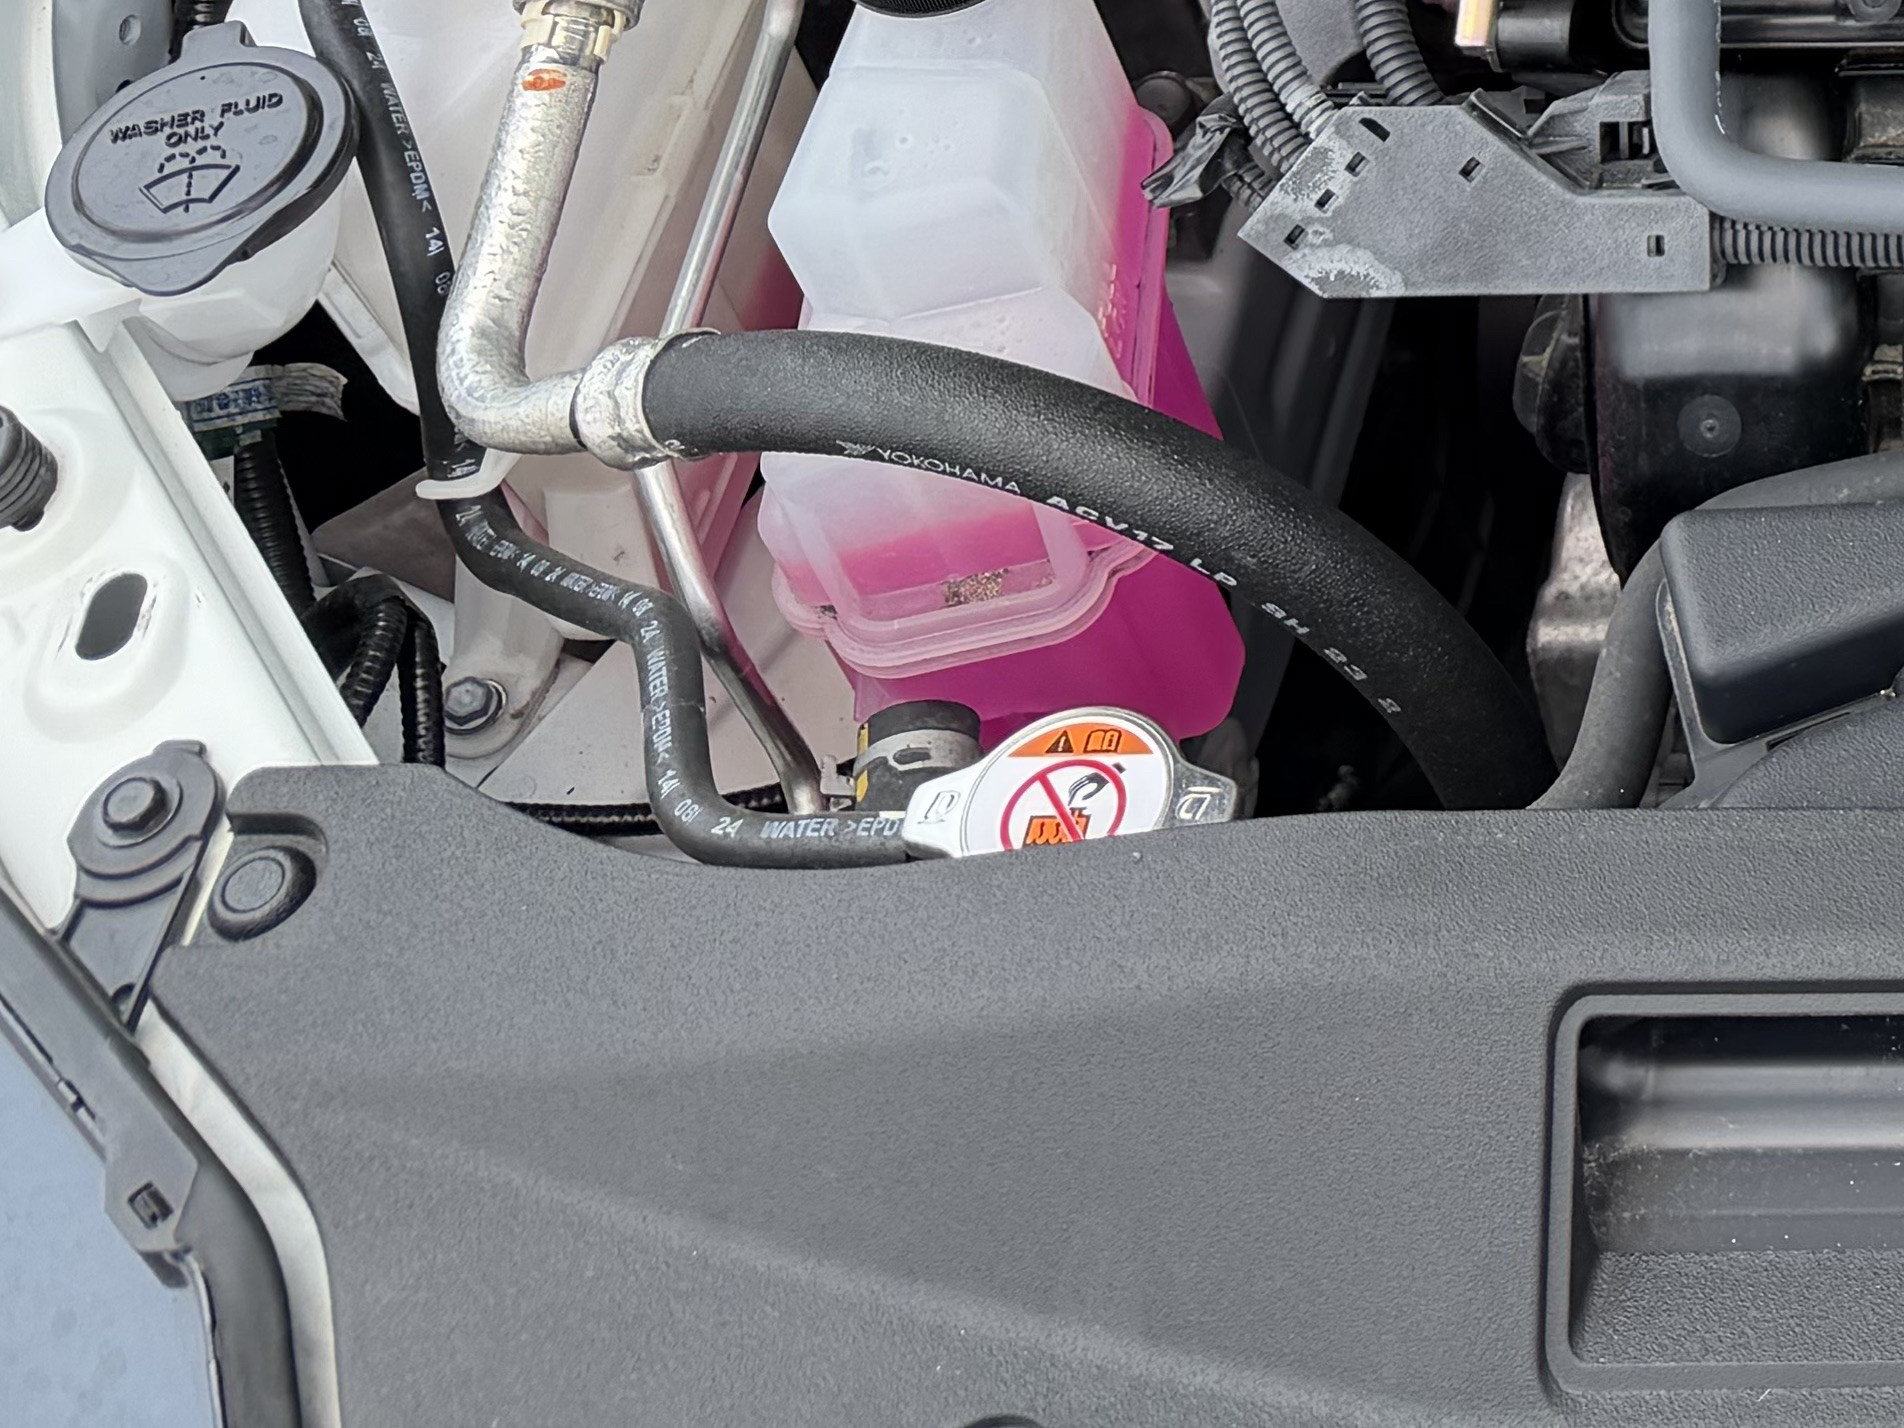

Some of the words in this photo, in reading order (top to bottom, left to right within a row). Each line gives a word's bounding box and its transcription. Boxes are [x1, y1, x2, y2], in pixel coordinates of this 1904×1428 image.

[109, 109, 206, 145] WASHER
[219, 92, 284, 119] FLUID
[164, 120, 225, 148] ONLY
[380, 81, 409, 135] WATER
[876, 446, 1022, 495] YOKOHAMA
[1046, 496, 1174, 550] ACV17
[1190, 558, 1238, 587] LP
[646, 646, 669, 704] WATER
[711, 816, 744, 838] 24
[759, 817, 838, 839] WATER
